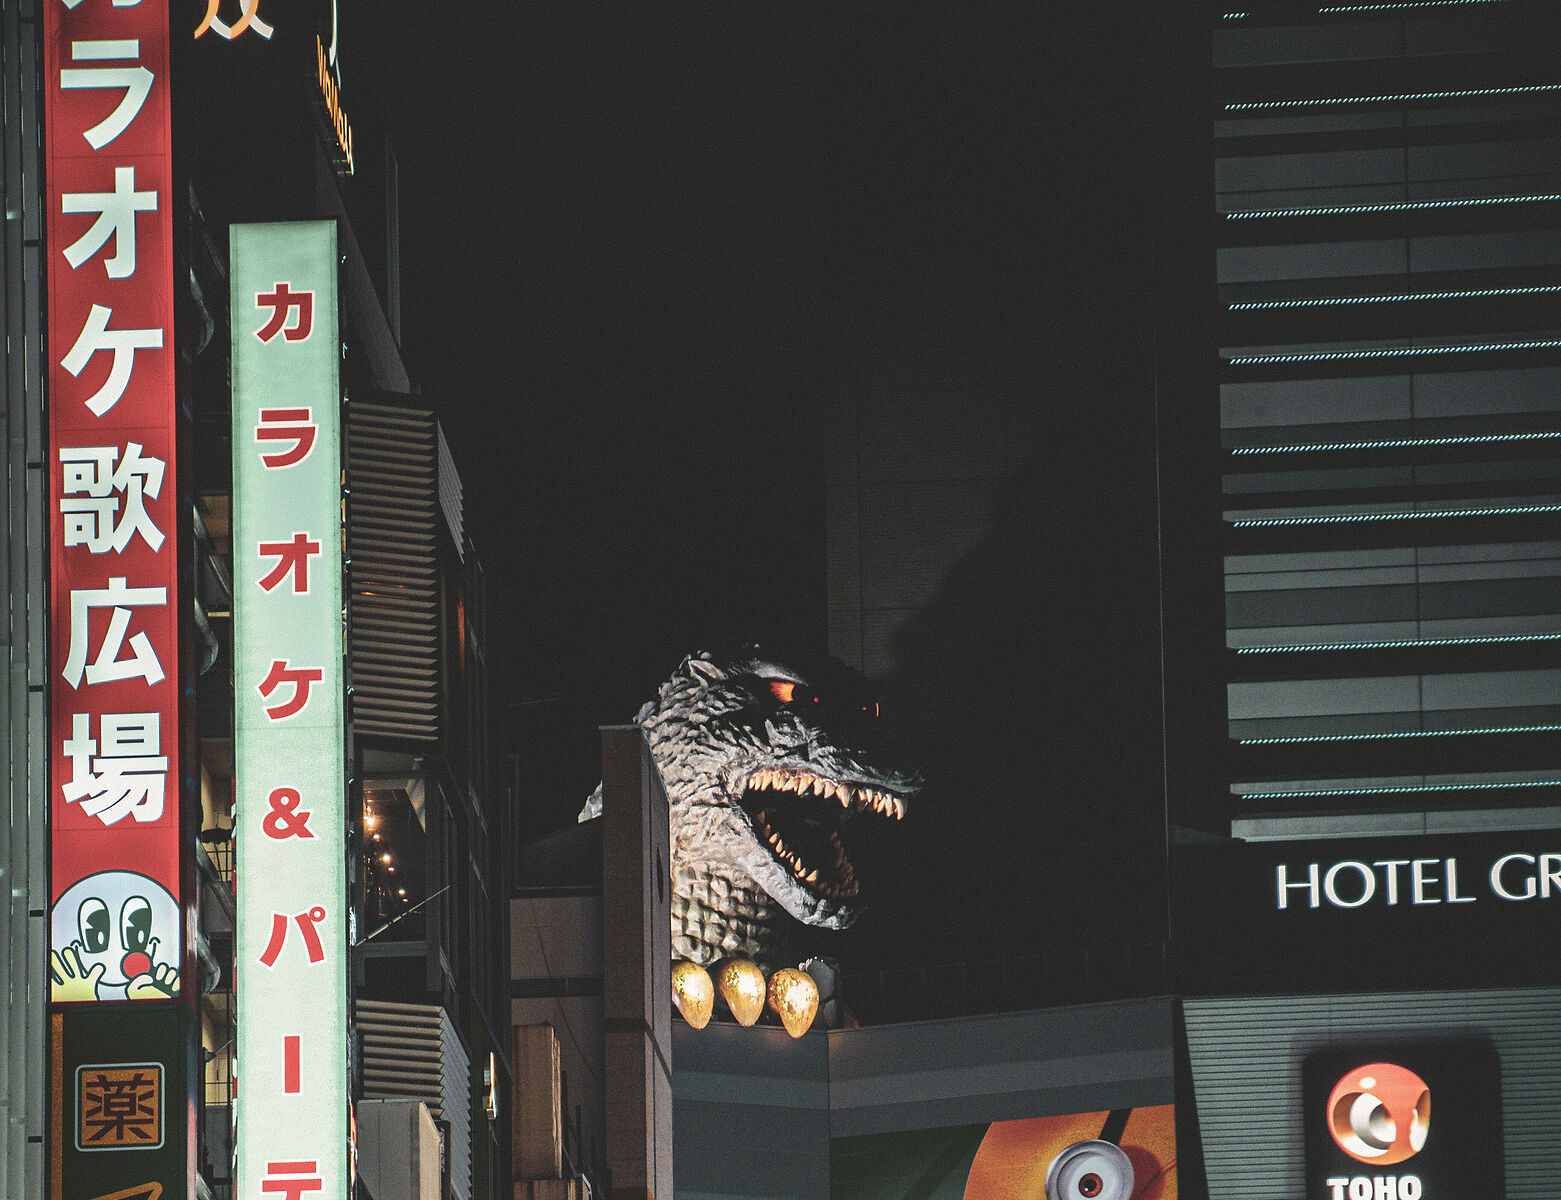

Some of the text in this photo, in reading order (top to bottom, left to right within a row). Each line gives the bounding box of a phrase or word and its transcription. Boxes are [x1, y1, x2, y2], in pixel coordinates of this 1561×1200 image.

[60, 0, 169, 825] ラオケ歌広場
[1277, 858, 1476, 909] HOTEL
[84, 1074, 157, 1143] 薬
